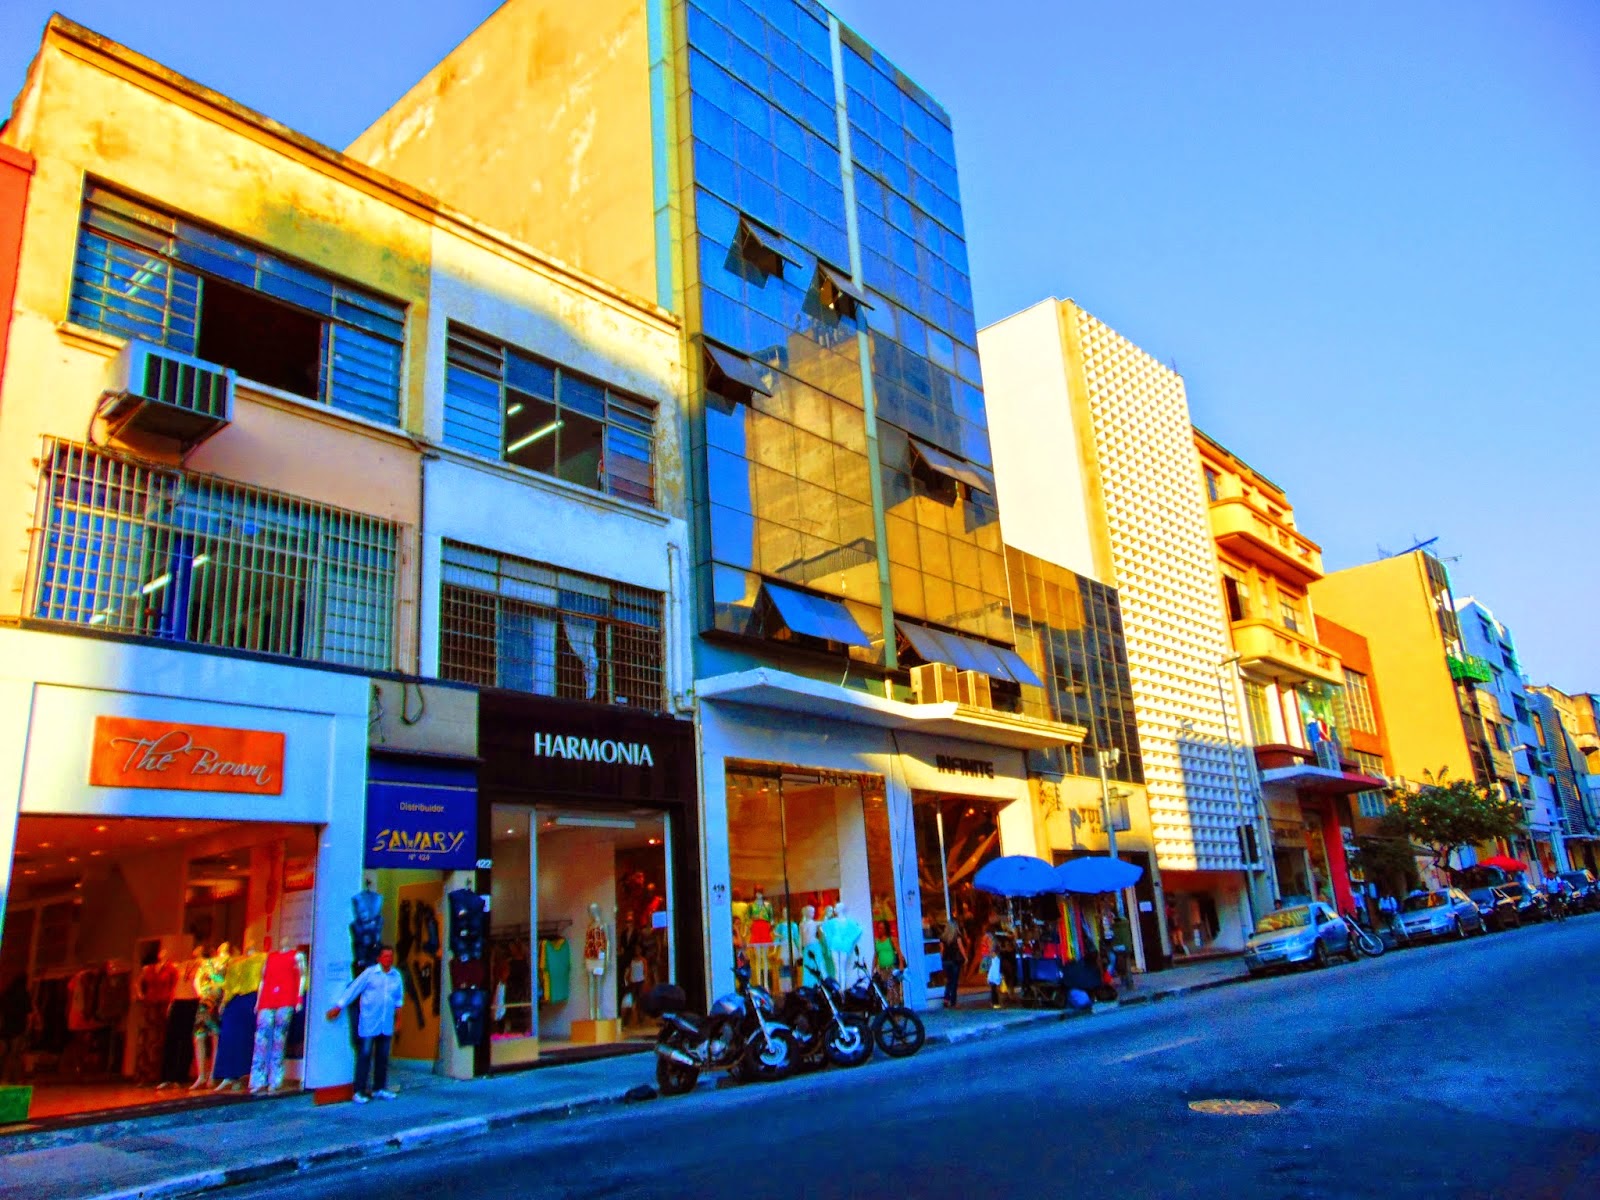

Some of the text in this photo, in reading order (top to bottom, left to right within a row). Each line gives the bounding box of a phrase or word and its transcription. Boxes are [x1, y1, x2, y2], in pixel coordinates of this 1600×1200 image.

[110, 730, 272, 786] The Brown
[534, 732, 654, 767] HARMONIA
[936, 754, 994, 779] INFINITE
[399, 801, 444, 813] Distribuidor
[372, 829, 465, 853] SAWARY
